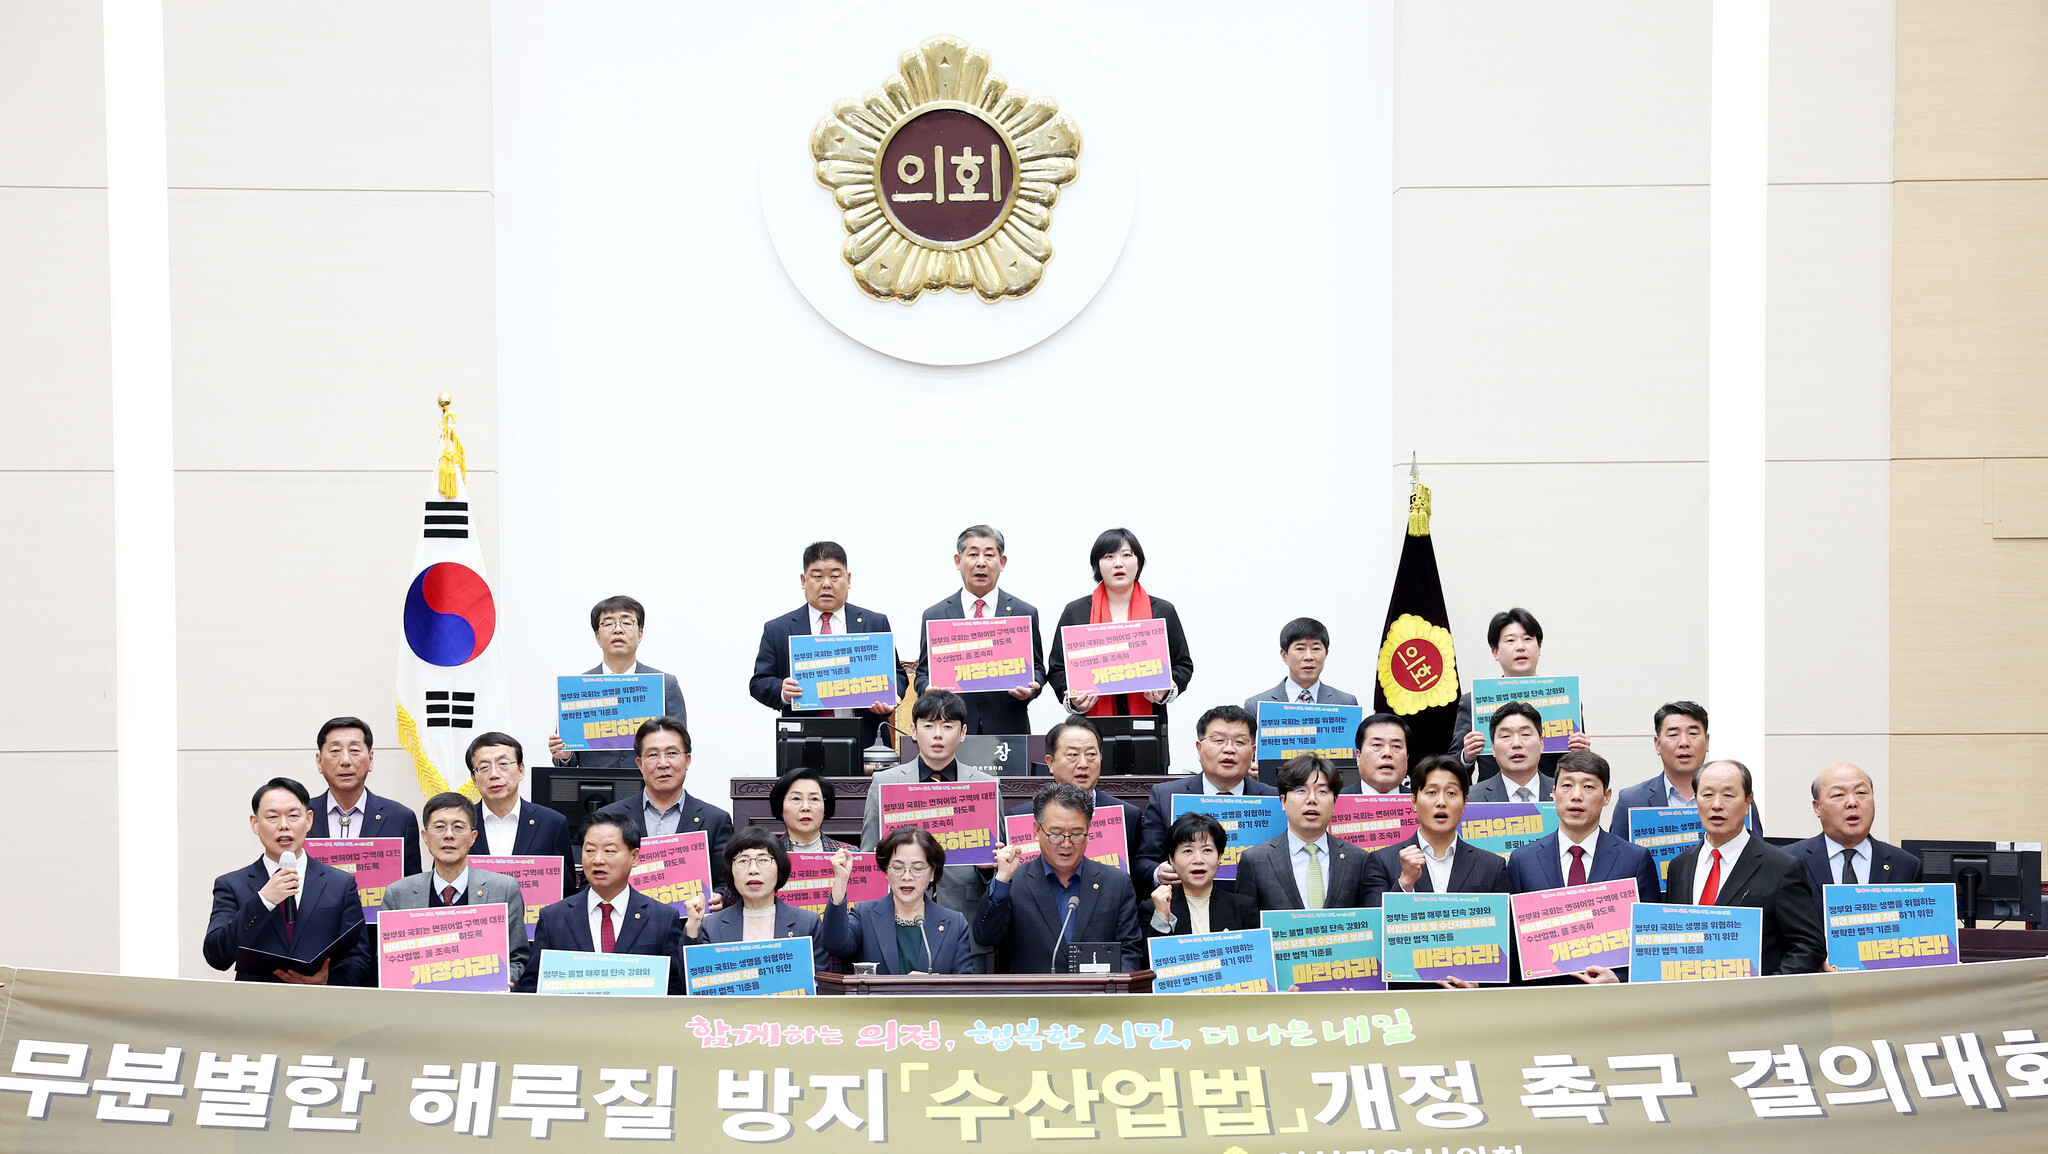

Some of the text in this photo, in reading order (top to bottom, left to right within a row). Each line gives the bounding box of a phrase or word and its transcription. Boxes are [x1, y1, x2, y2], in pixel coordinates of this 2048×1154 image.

[892, 144, 1001, 204] 의회
[794, 652, 812, 660] 정부와
[834, 647, 853, 655] 생명을
[854, 644, 879, 652] 위협하는
[831, 667, 850, 675] 기준을
[954, 657, 1027, 681] 개정하라!
[1091, 659, 1163, 685] 개정하라!
[1397, 646, 1438, 689] 의회
[602, 688, 620, 696] 생명을
[622, 685, 648, 693] 위협하는
[816, 674, 889, 698] 마련하라!
[1475, 696, 1494, 704] 정부는
[1511, 691, 1529, 700] 해루질
[1545, 687, 1565, 695] 강화와
[562, 708, 618, 720] 명확한 법적 기준을
[994, 742, 1011, 761] 장
[883, 792, 995, 811] 정부와 국회는 면허어업 구역에 대한
[1221, 809, 1271, 819] 생명을 위협하는
[1376, 809, 1403, 818] 면허어업
[932, 819, 954, 828] 조속히
[1108, 816, 1122, 825] 대한
[1254, 820, 1268, 828] 위한
[1379, 831, 1400, 840] 조속히
[1634, 828, 1655, 836] 정부와
[668, 842, 704, 855] 구역에 대한
[1660, 847, 1675, 855] 법적
[331, 853, 360, 862] 면허어업
[362, 851, 384, 859] 구역에
[386, 849, 400, 857] 대한
[643, 873, 665, 883] 조속히
[1518, 890, 1635, 922] 정부와 국회는 면허어업 구역에 대한
[1829, 898, 1936, 914] 정부와 국회는 생명을 위협하는
[1386, 914, 1408, 922] 정부는
[1411, 912, 1425, 920] 불법
[1428, 910, 1450, 918] 해루질
[1468, 907, 1491, 915] 강화와
[1917, 909, 1934, 918] 위한
[383, 915, 505, 940] 정부와 국회는 면허어업 구역에 대한
[1306, 926, 1327, 934] 해루질
[1330, 924, 1344, 932] 단속
[1346, 921, 1368, 930] 강화와
[1571, 922, 1594, 933] 조속히
[1635, 921, 1741, 932] 정부와 국회는 생명을 위협하는
[1831, 924, 1900, 938] 명확한 법적 기준을
[1388, 933, 1454, 945] 명확한 법적 기준을
[1722, 932, 1738, 940] 위한
[436, 946, 459, 956] 조속히
[1292, 948, 1332, 959] 법적 기준을
[1636, 946, 1704, 956] 명확한 법적 기준을
[1858, 934, 1949, 961] 마련하라!
[1155, 944, 1254, 966] 정부와 국회는 생명을 위협하는
[1238, 955, 1253, 963] 위한
[1413, 944, 1499, 968] 마련하라!
[410, 954, 500, 985] 개정하라!
[690, 953, 794, 976] 정부와 국회는 생명을 위협하는
[776, 964, 792, 973] 위한
[1292, 957, 1378, 984] 마련하라!
[1661, 958, 1750, 980] 마련하라!
[1158, 980, 1181, 989] 명확한
[1183, 976, 1197, 985] 법적
[1200, 972, 1222, 982] 기준을
[719, 982, 760, 994] 법적 기준을
[686, 1008, 1416, 1052] 함께하는 의정, 행복한 시민, 더 나은 내일
[0, 1038, 374, 1132] 무분별한
[408, 1060, 679, 1140] 해루질
[1519, 1052, 1698, 1125] 촉구
